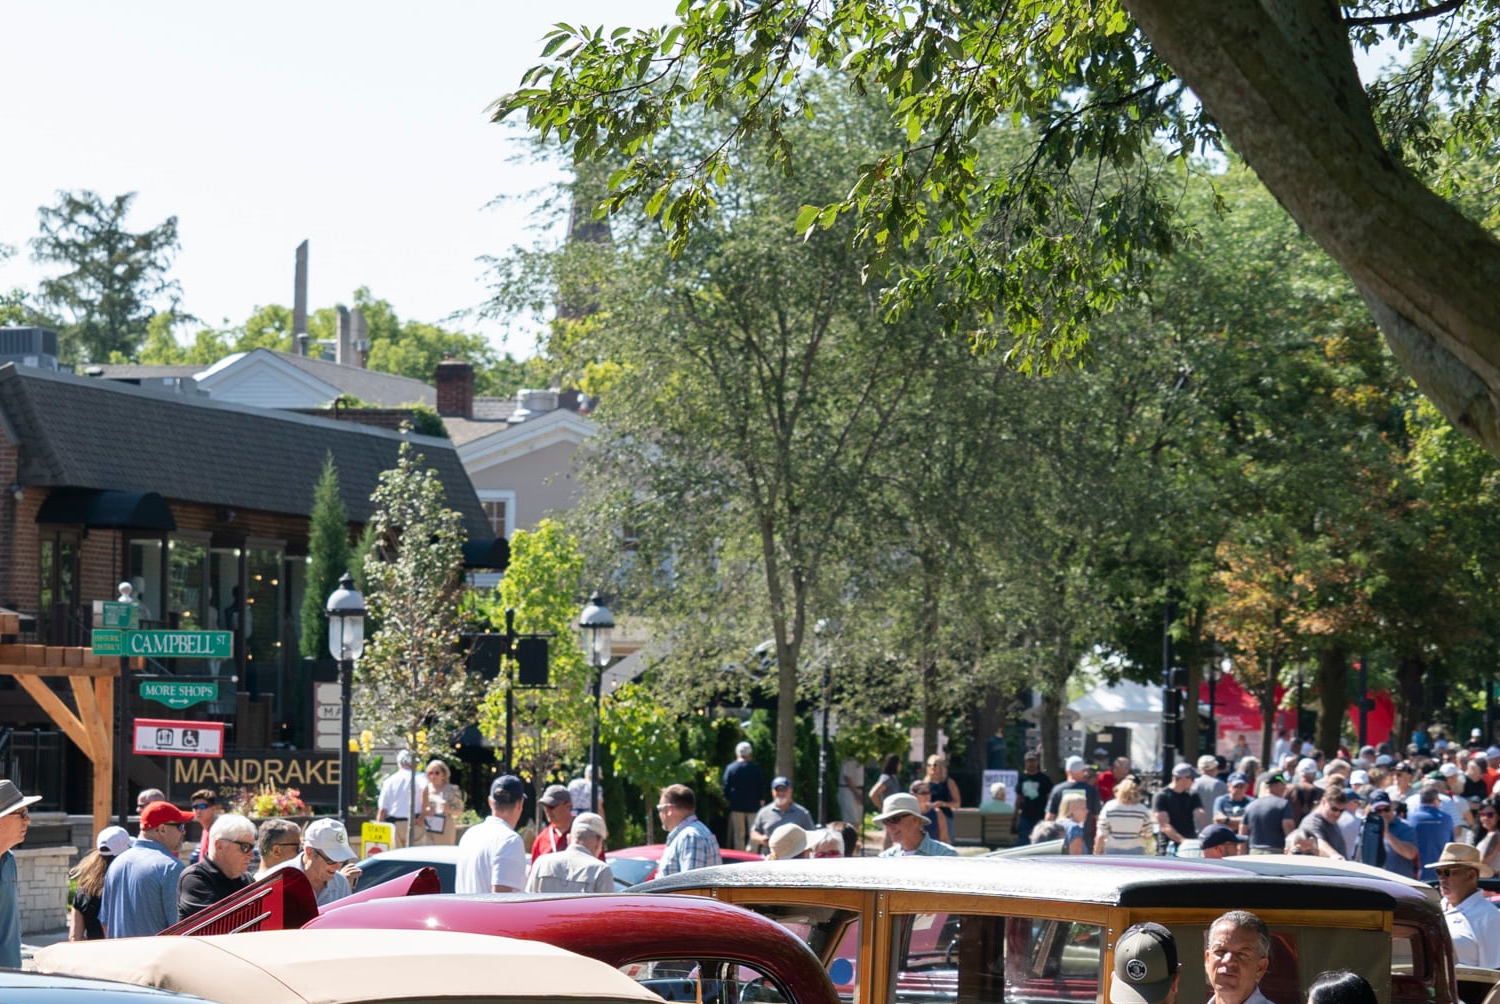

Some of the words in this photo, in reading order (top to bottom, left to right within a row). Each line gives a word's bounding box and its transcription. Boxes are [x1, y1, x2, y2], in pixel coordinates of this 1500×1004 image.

[131, 633, 215, 654] CAMPBELL
[216, 635, 227, 645] ST
[145, 685, 177, 696] MORE
[178, 685, 213, 697] SHOPS
[174, 759, 341, 785] MANDRAKE
